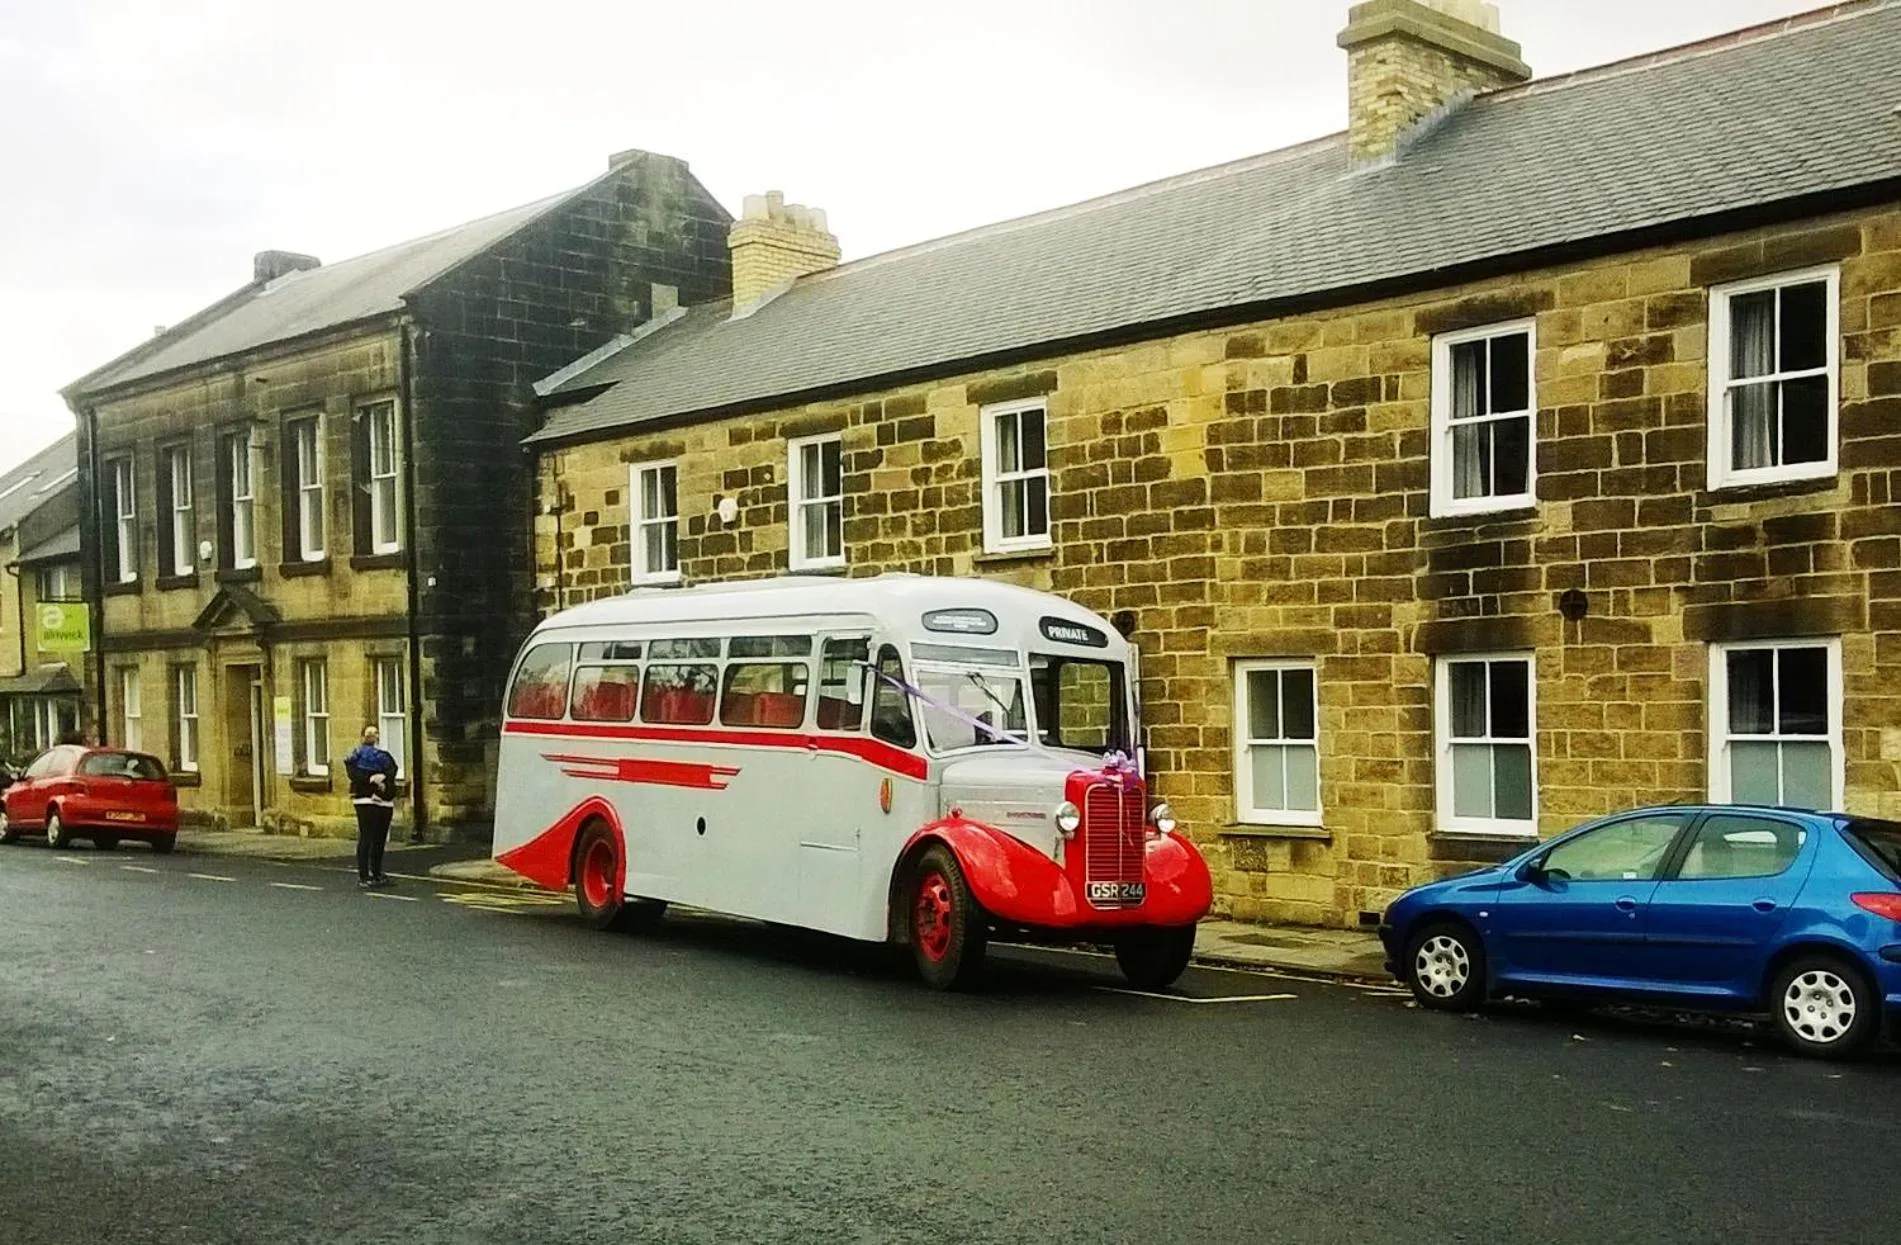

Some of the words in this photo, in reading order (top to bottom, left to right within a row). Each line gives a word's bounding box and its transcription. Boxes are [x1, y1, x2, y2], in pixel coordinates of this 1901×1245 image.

[1047, 625, 1089, 641] PRIVATE
[1091, 883, 1119, 898] GSR
[1121, 883, 1143, 897] 244
